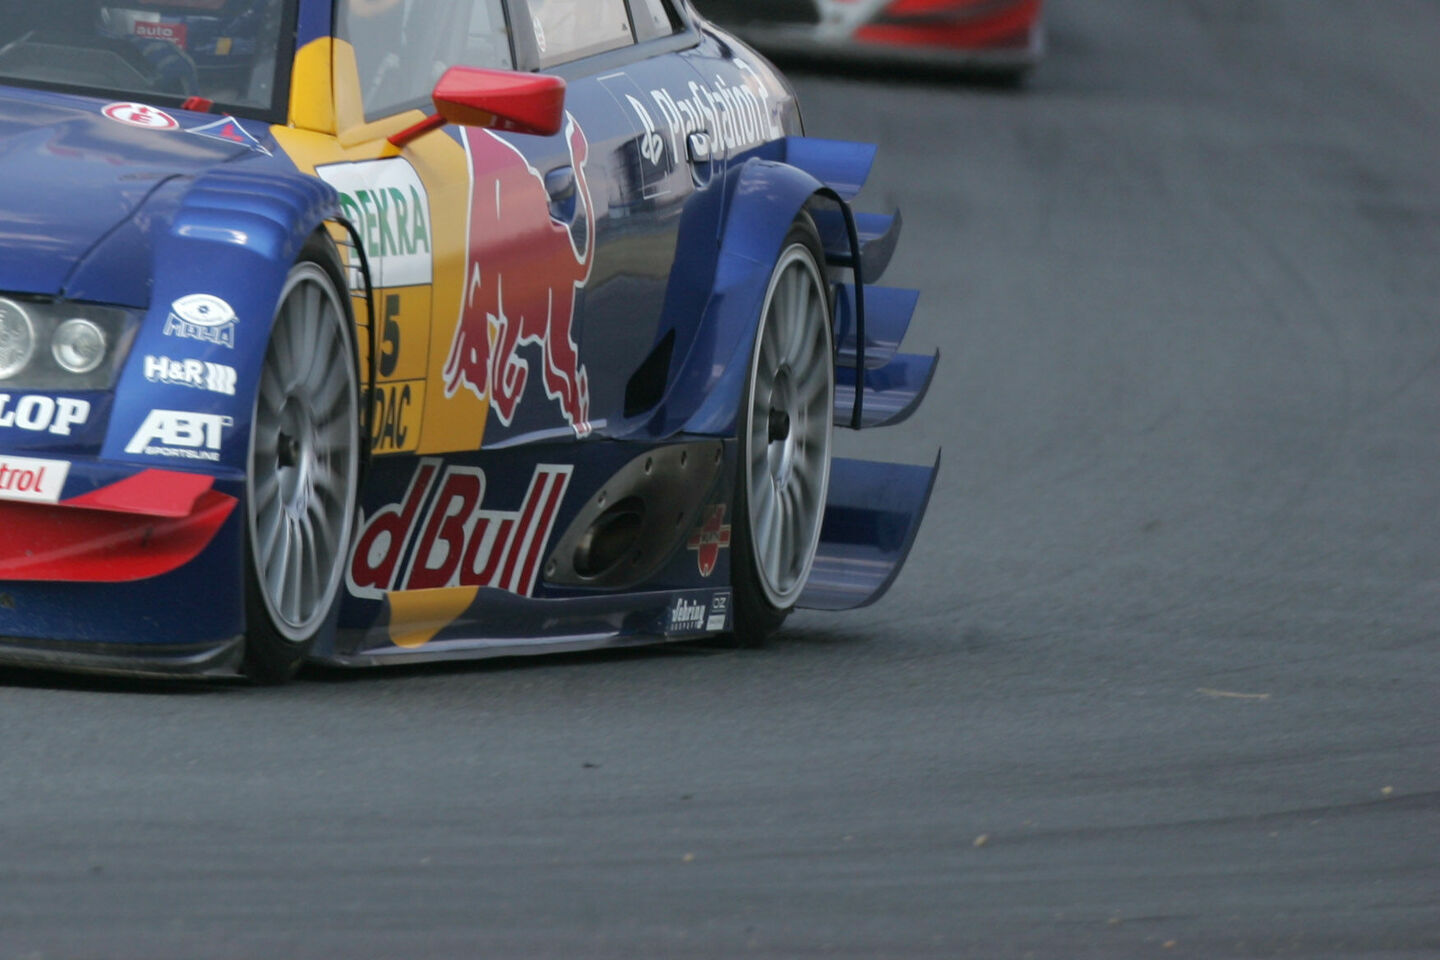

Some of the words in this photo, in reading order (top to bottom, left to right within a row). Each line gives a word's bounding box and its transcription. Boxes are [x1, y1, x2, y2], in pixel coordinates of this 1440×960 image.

[136, 25, 174, 38] auto
[340, 185, 430, 260] DEKRA
[144, 354, 206, 390] H&R
[123, 408, 222, 455] ABT
[360, 383, 411, 449] DAC
[400, 462, 575, 599] Bull
